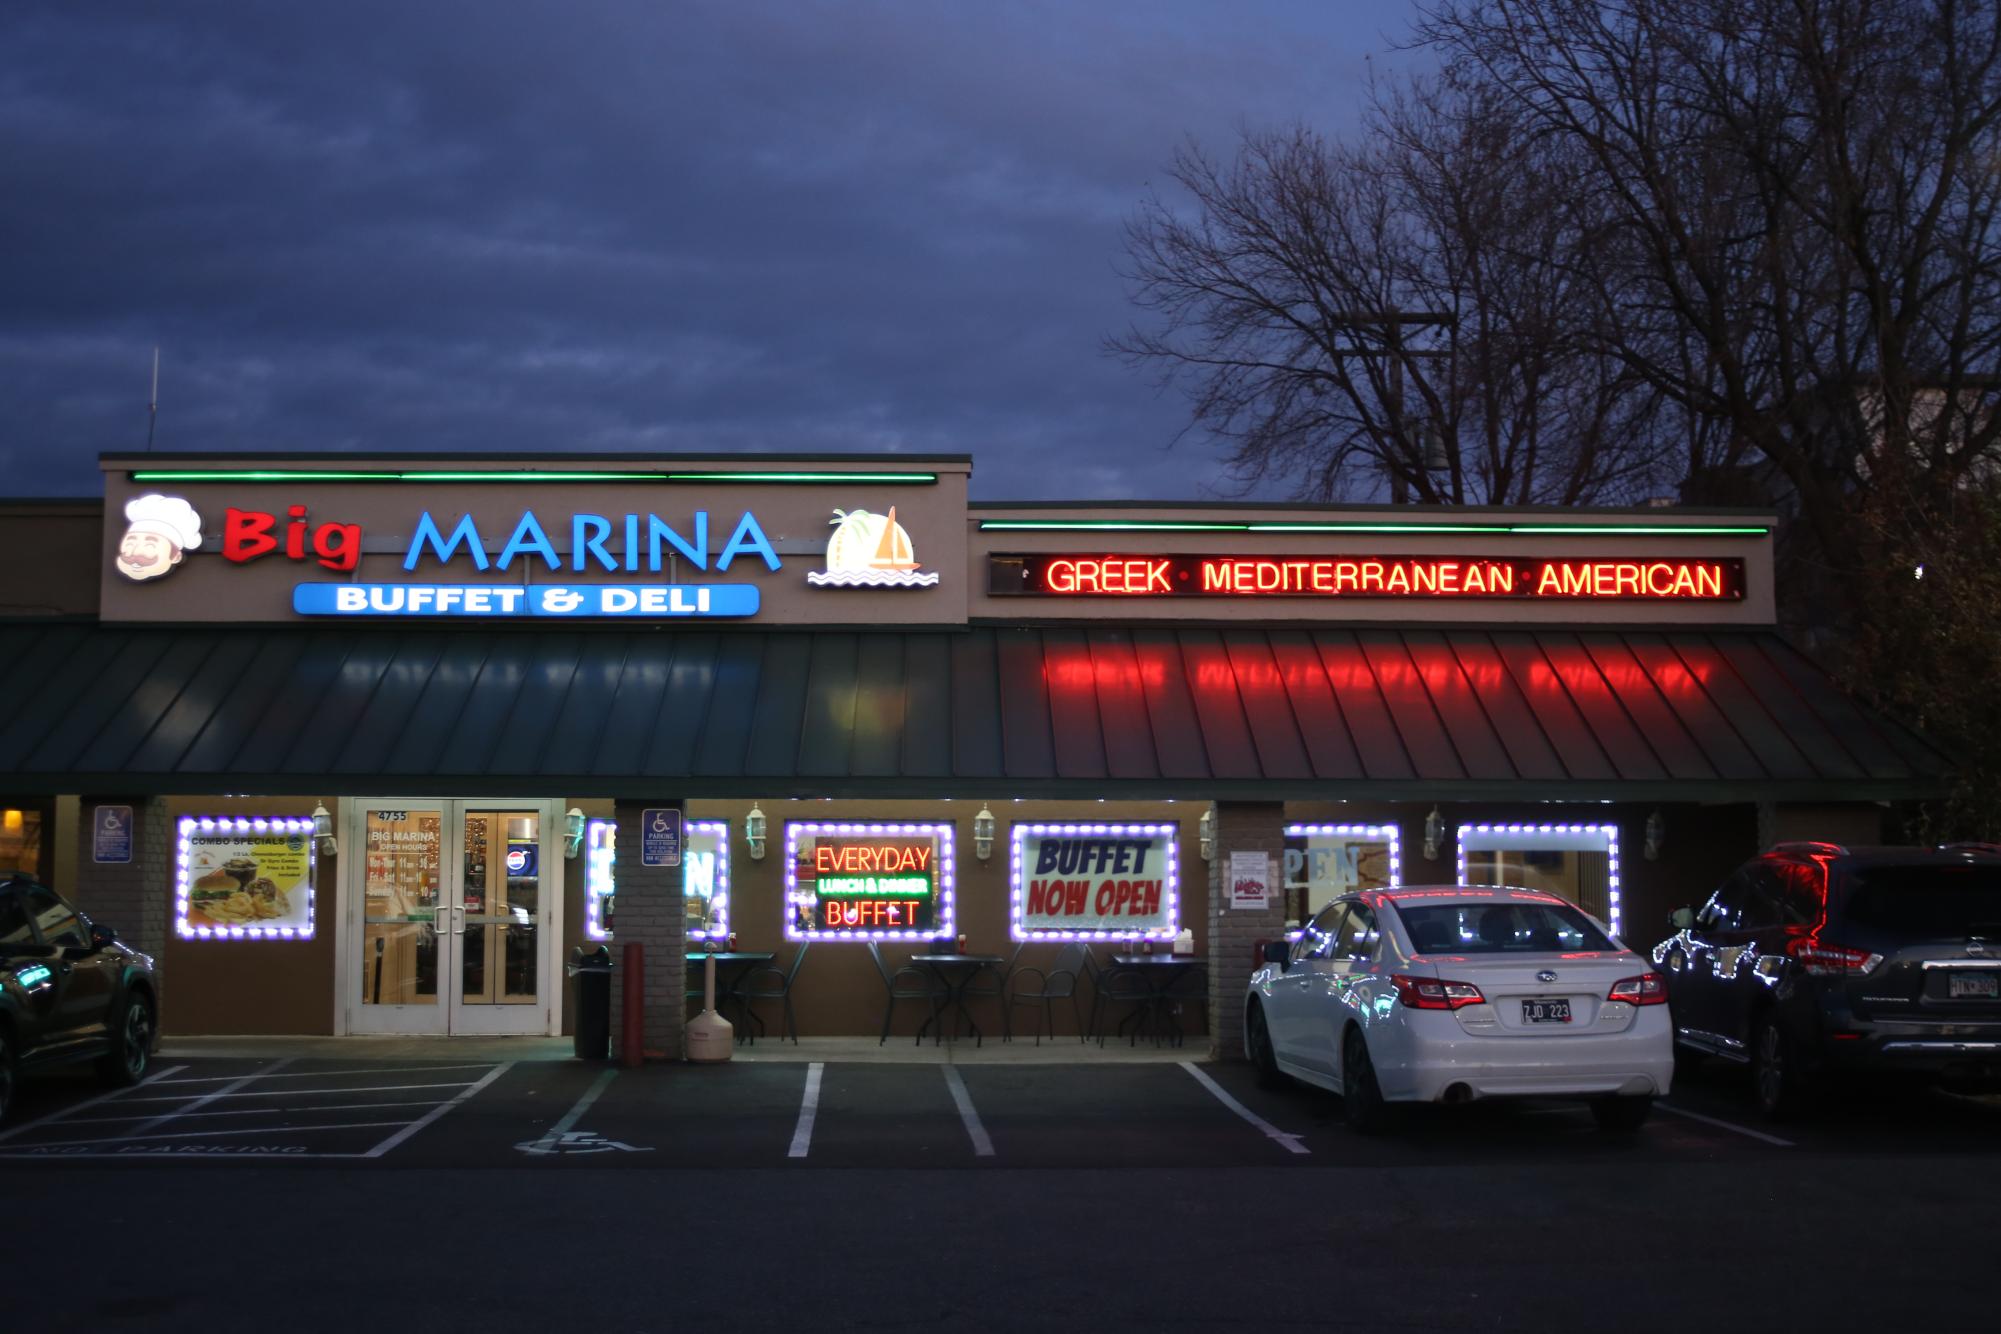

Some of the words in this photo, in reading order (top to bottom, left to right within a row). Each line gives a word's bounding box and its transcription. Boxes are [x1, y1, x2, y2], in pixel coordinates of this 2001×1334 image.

[222, 505, 362, 572] Big
[403, 511, 782, 573] MARINA
[1047, 560, 1171, 592] GREEK
[1203, 561, 1512, 593] MEDITERRANEAN
[1538, 563, 1721, 596] AMERICAN
[336, 587, 525, 612] BUFFET
[541, 588, 585, 612] &
[601, 588, 710, 612] DELI
[378, 811, 406, 821] 4755
[191, 837, 231, 846] COMBO
[233, 837, 285, 846] SPECIALS
[372, 831, 390, 841] BIG
[393, 831, 435, 841] MARINA
[816, 847, 931, 871] EVERYDAY
[1035, 839, 1152, 875] BUFFET
[819, 878, 864, 893] LUNCH
[865, 877, 878, 893] &
[879, 878, 928, 893] DINNER
[1027, 879, 1091, 916] NOW
[1095, 879, 1163, 916] OPEN
[827, 901, 919, 925] BUFFET
[1549, 1004, 1570, 1017] 223
[117, 1145, 308, 1153] PARKING
